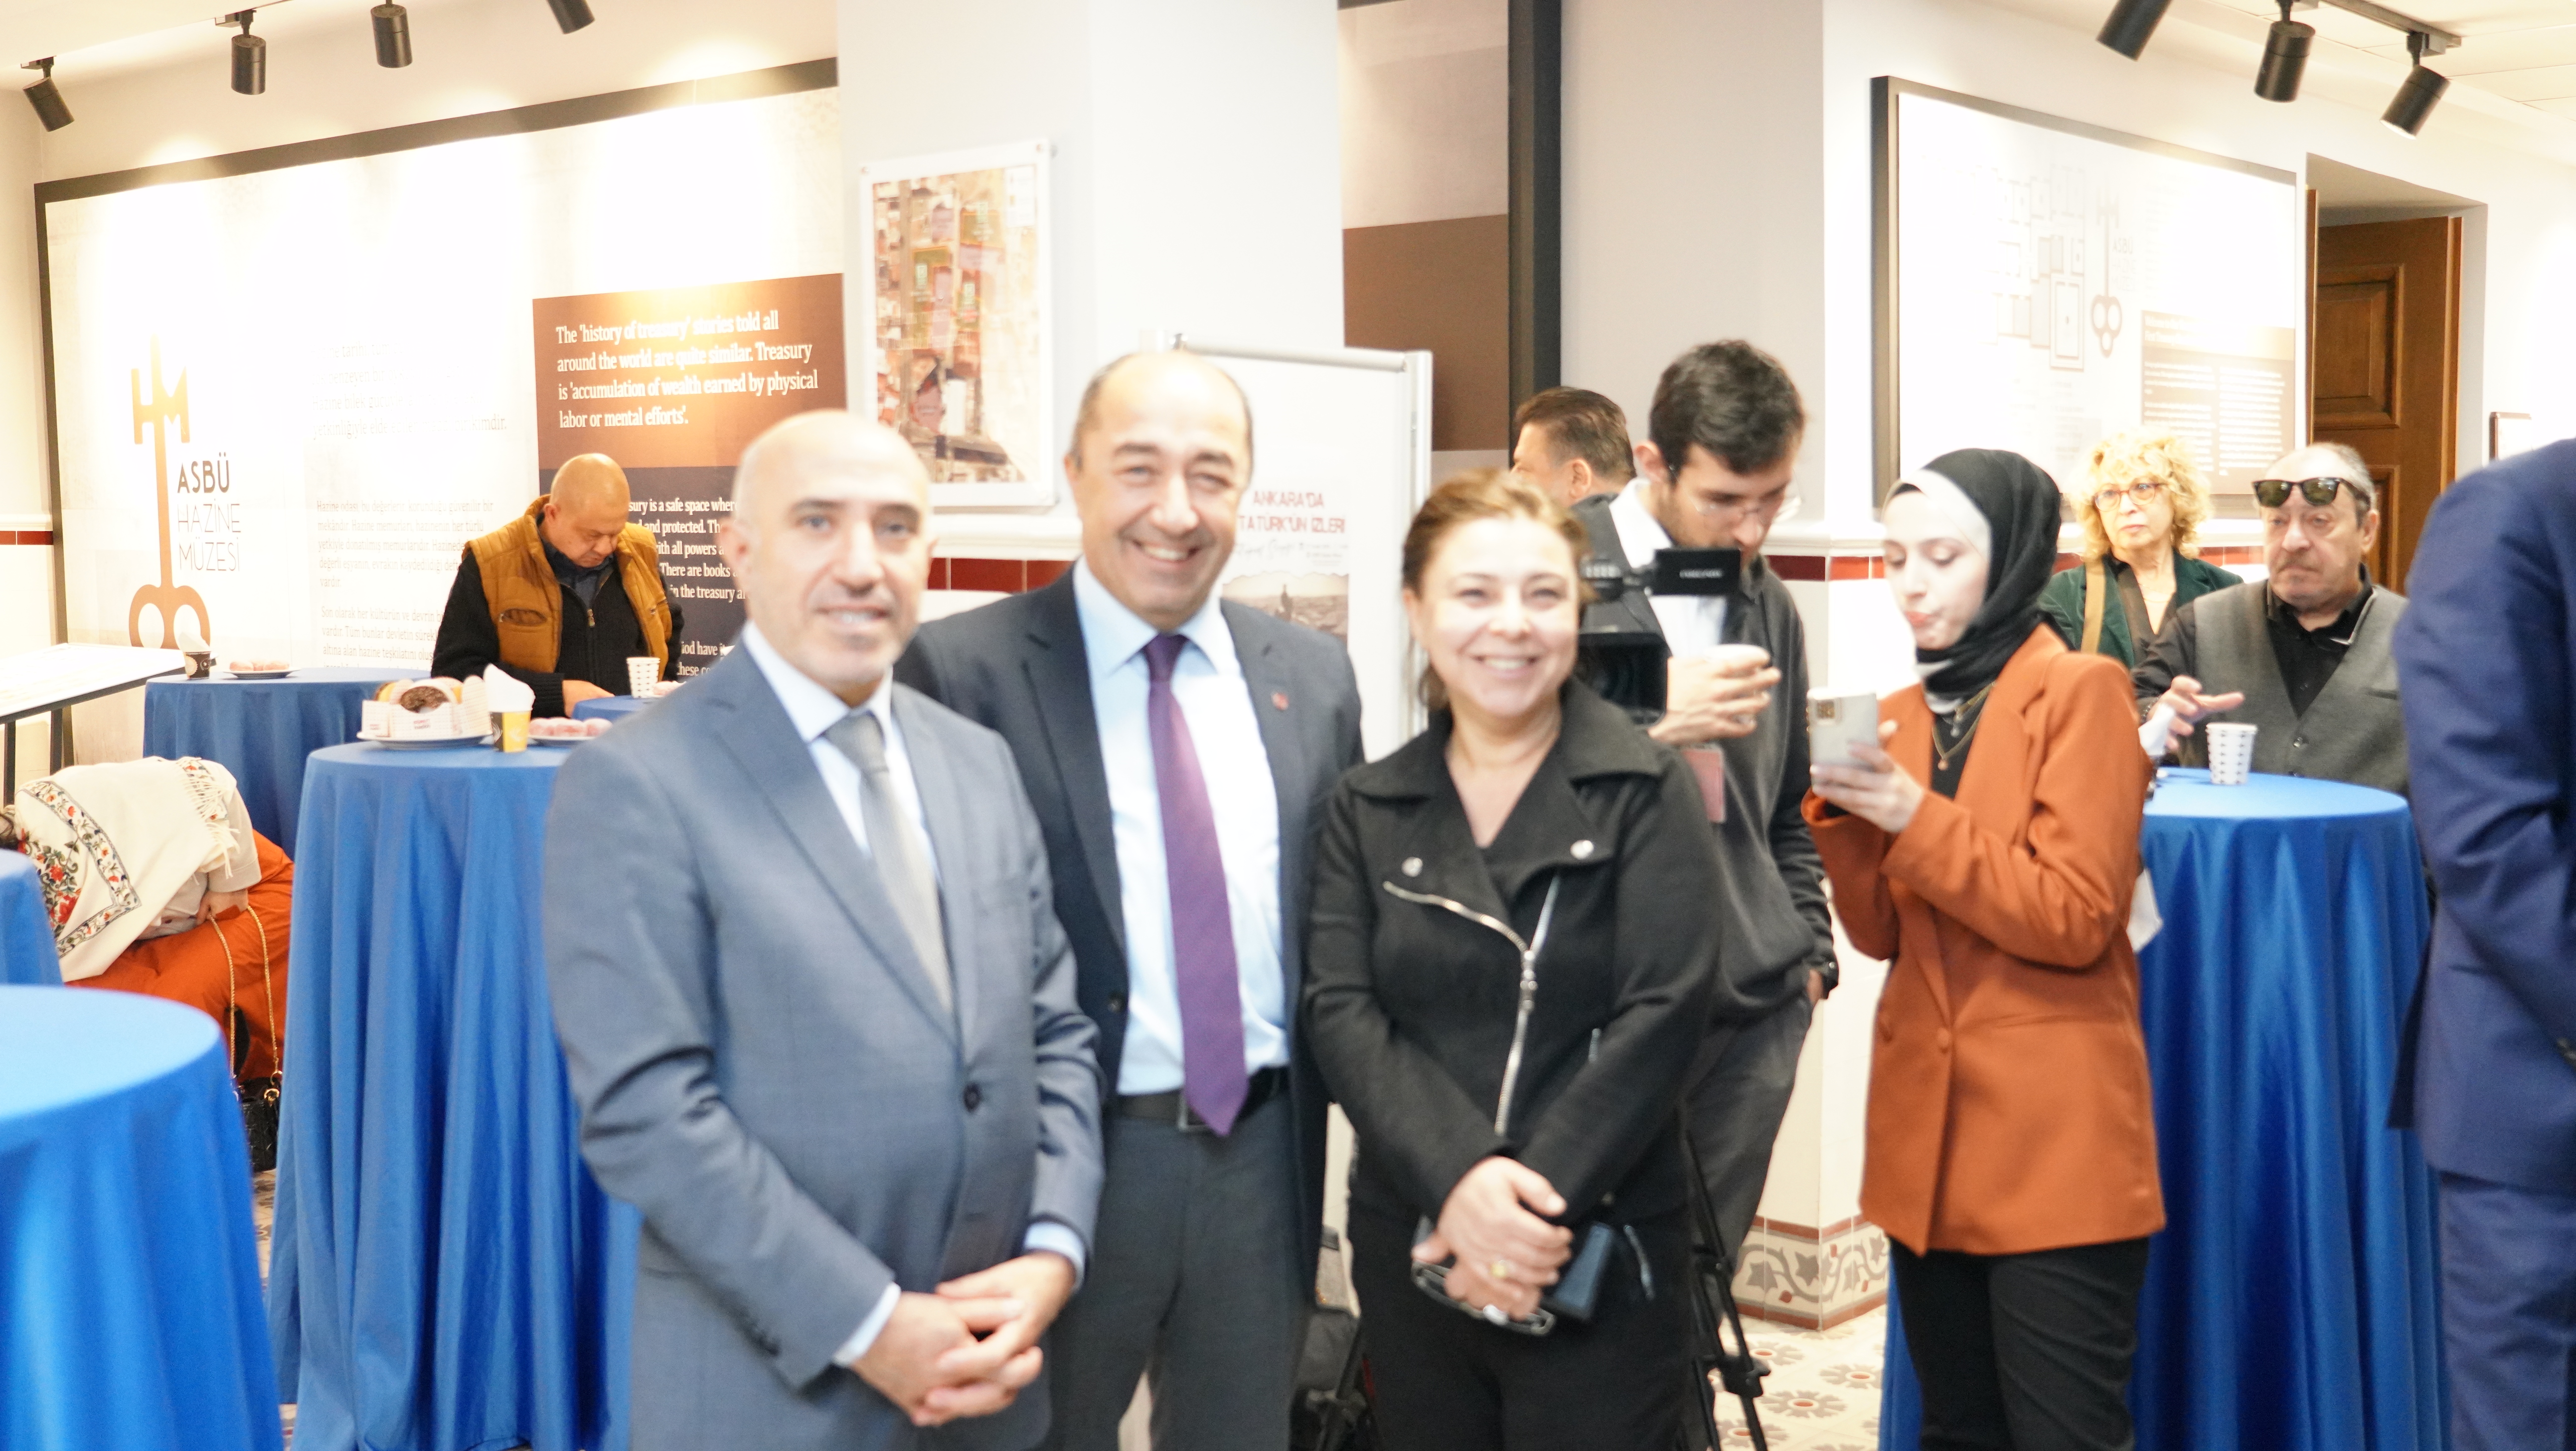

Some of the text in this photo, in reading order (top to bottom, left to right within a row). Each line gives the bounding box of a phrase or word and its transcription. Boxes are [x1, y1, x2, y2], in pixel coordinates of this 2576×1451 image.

[556, 325, 577, 344] The
[580, 323, 623, 345] 'history
[624, 320, 637, 339] of
[693, 314, 734, 335] stories
[736, 311, 761, 332] told
[763, 310, 779, 330] all
[557, 341, 812, 372] around the world are quite similar. Treasury
[328, 369, 370, 387] benzeyen
[558, 369, 818, 400] is 'accumulation of wealth earned by physical
[313, 396, 342, 410] Hazine
[344, 393, 366, 409] bilek
[370, 418, 388, 434] elde
[559, 410, 588, 428] labor
[589, 414, 603, 427] or
[605, 407, 643, 427] mental
[177, 451, 230, 494] ASBÜ
[317, 500, 339, 512] Hazine
[361, 500, 370, 512] bu
[408, 499, 447, 515] korunduğu
[449, 499, 481, 515] güvenilir
[483, 499, 493, 512] bir
[649, 498, 657, 512] is
[658, 501, 664, 512] a
[665, 497, 683, 512] safe
[684, 501, 710, 515] space
[1253, 490, 1325, 508] ANKARA'DA
[177, 498, 241, 533] HAZİNE
[1238, 512, 1307, 532] TATÜRK'ÜN
[352, 519, 374, 531] Hazine
[416, 519, 450, 532] hazinenin
[452, 519, 464, 532] her
[466, 519, 484, 532] türlü
[662, 519, 706, 537] protected.
[179, 537, 240, 572] MÜZESİ
[318, 538, 344, 553] yetkiyle
[346, 538, 381, 553] donatılmış
[655, 540, 670, 555] ith
[671, 541, 682, 555] all
[684, 544, 717, 559] powers
[319, 557, 341, 572] değerli
[372, 558, 398, 570] evrakın
[400, 558, 443, 574] kaydedildiği
[659, 562, 731, 577] There are books
[320, 576, 341, 587] vardır.
[680, 583, 695, 598] the
[696, 585, 735, 603] treasury
[322, 606, 333, 618] Son
[335, 606, 355, 619] olarak
[357, 607, 368, 619] her
[370, 607, 400, 621] kültürün
[402, 612, 410, 621] ve
[412, 608, 435, 622] devrin
[322, 625, 343, 637] vardır.
[345, 625, 360, 638] Tüm
[362, 626, 384, 639] bunlar
[386, 627, 413, 641] devletin
[323, 643, 341, 656] altına
[343, 644, 357, 657] alan
[359, 645, 380, 658] hazine
[383, 646, 416, 662] teşkilatını
[697, 641, 718, 656] have
